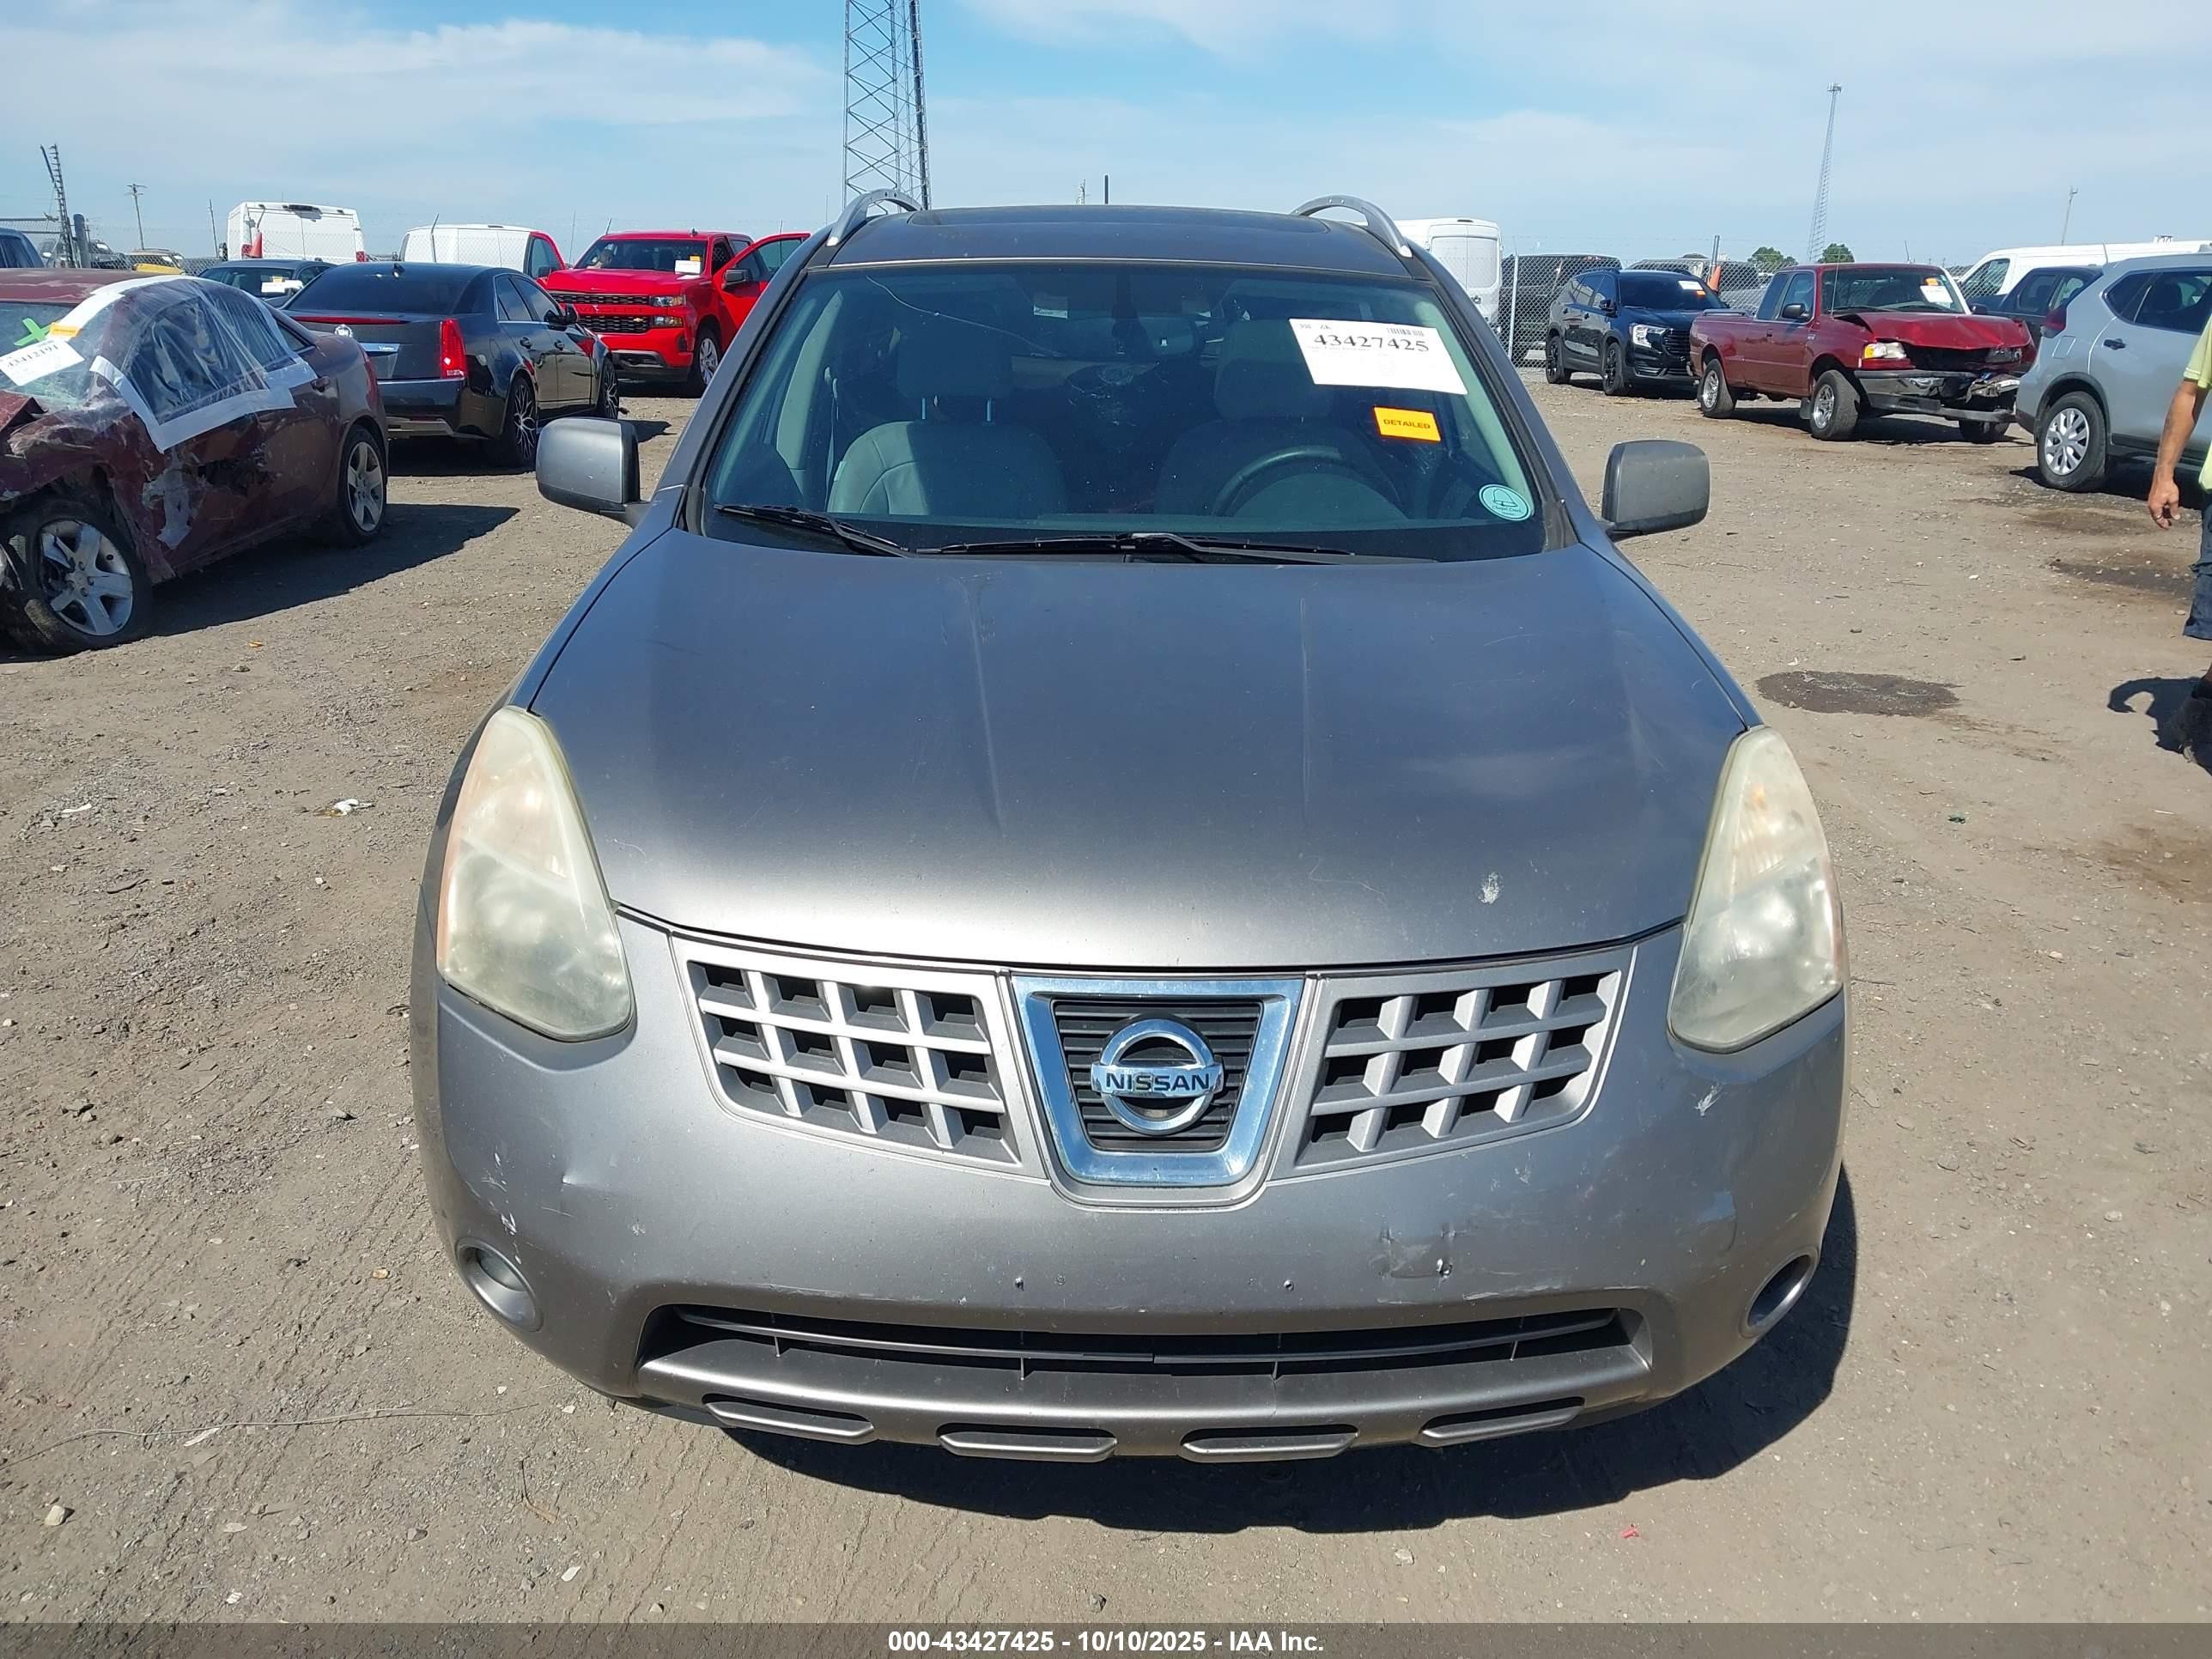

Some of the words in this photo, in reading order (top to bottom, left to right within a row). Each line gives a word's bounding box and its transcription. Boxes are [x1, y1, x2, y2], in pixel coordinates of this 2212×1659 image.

[1314, 334, 1430, 352] 43427425
[1383, 418, 1431, 429] DETAILED
[1106, 1073, 1209, 1091] NISSAN
